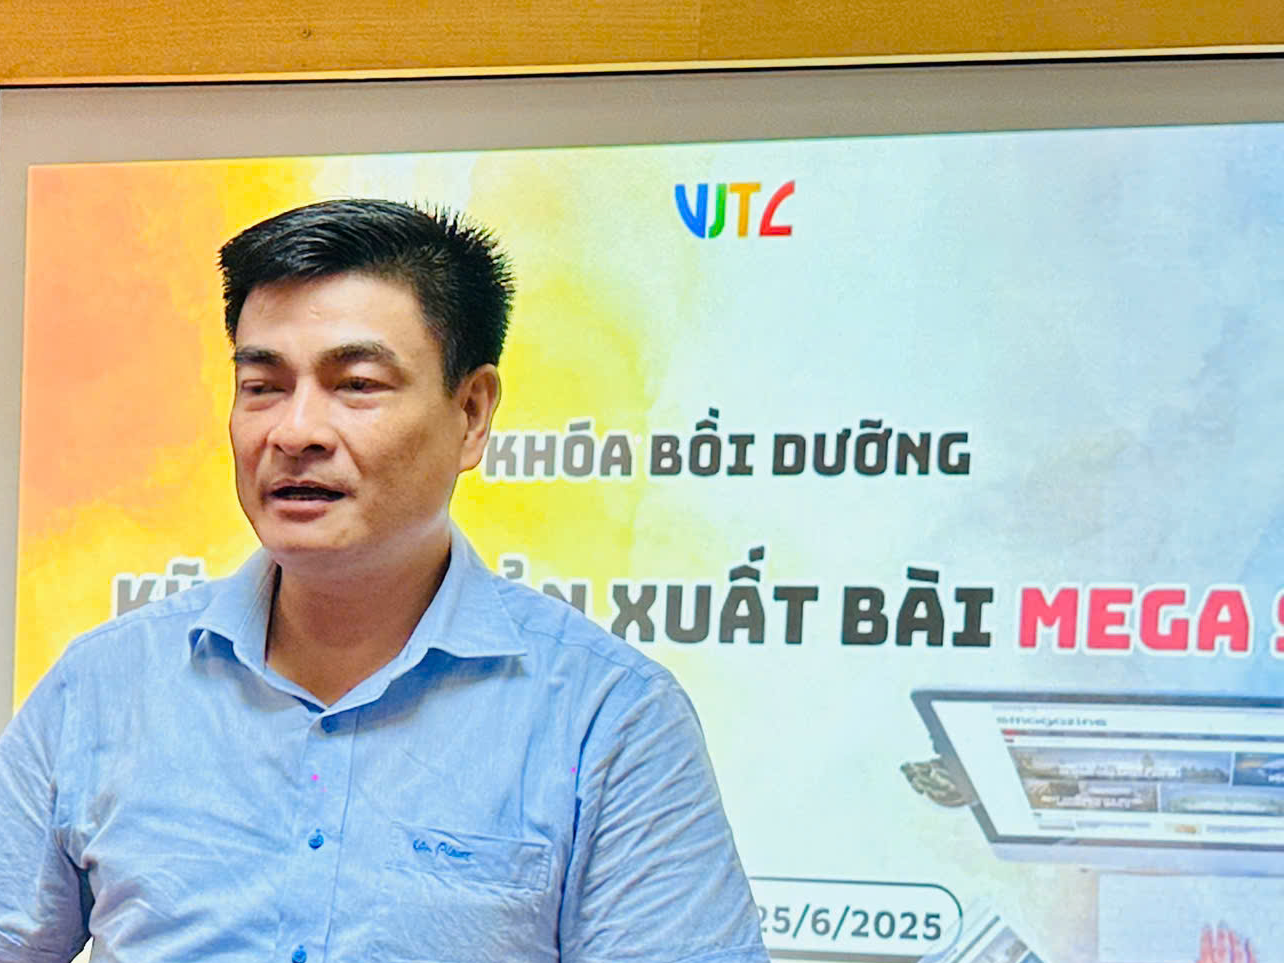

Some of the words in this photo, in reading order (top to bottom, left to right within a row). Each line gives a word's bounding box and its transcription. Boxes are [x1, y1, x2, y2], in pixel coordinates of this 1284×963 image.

[674, 180, 796, 239] VJTC
[485, 421, 633, 477] KHÓA
[650, 407, 755, 476] BỒI
[772, 418, 972, 476] DƯỠNG
[611, 545, 819, 644] XUẤT
[840, 566, 994, 648] BÀI
[1019, 587, 1250, 652] MEGA
